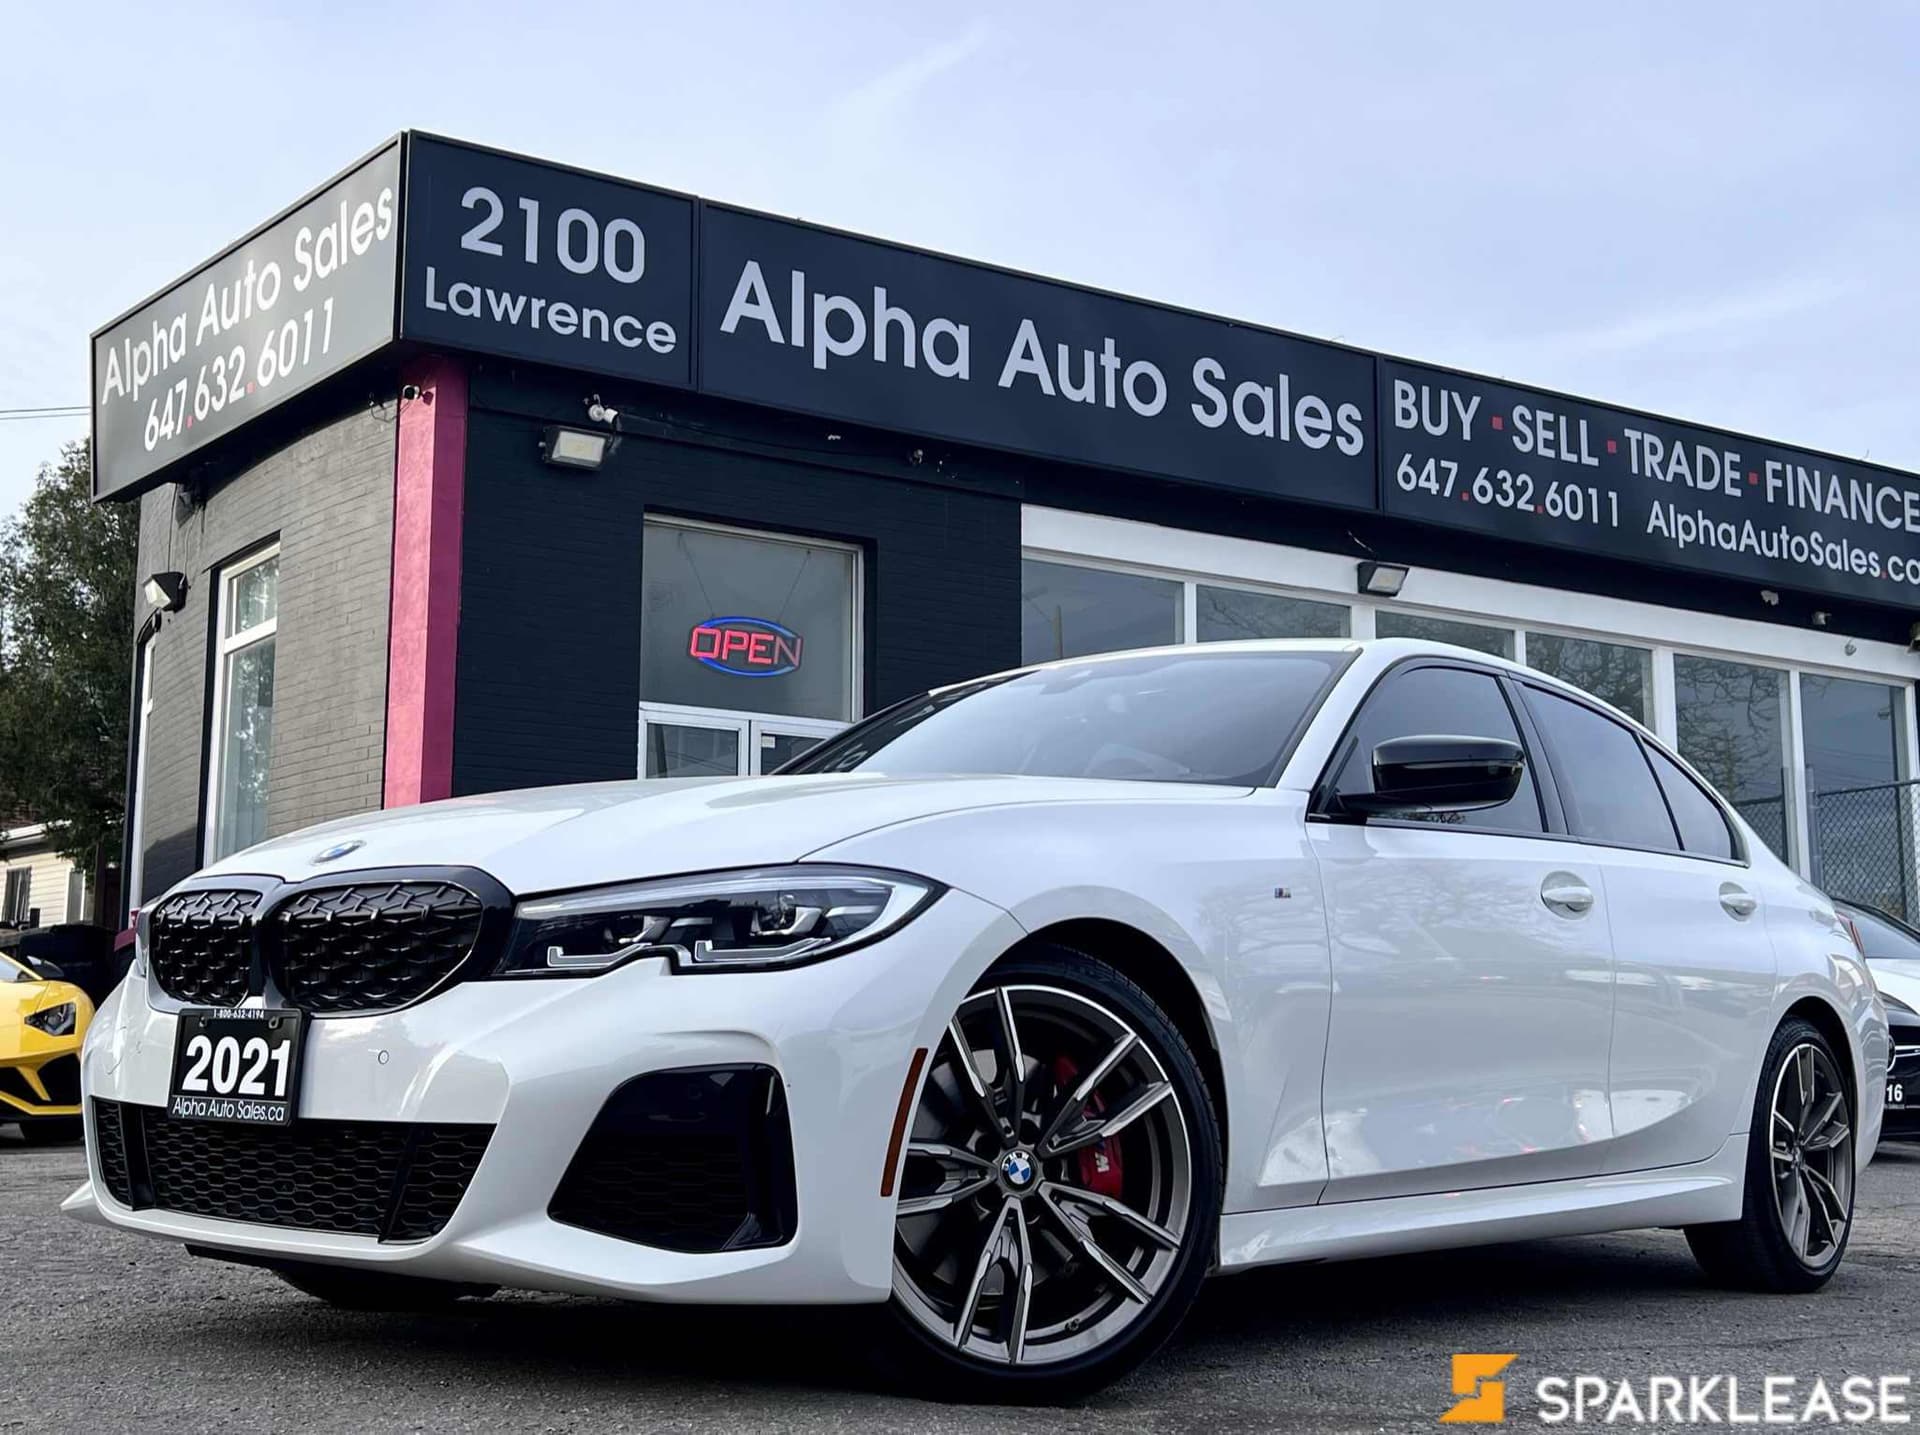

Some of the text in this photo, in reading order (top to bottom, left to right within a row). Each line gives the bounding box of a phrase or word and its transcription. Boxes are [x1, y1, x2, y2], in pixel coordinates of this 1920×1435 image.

[460, 186, 646, 284] 2100
[101, 186, 393, 406] Alpha Auto Sales
[425, 266, 678, 355] Lawrence
[143, 297, 334, 452] 647.632.6011
[719, 259, 1365, 457] Alpha Auto Sales
[1393, 379, 1920, 534] BUY SELL TRADE FINANCE
[1396, 453, 1619, 528] 647.632.6011
[689, 626, 802, 667] OPEN
[172, 1097, 285, 1121] Alpha Auto Sales.ca
[181, 1035, 291, 1096] 2021
